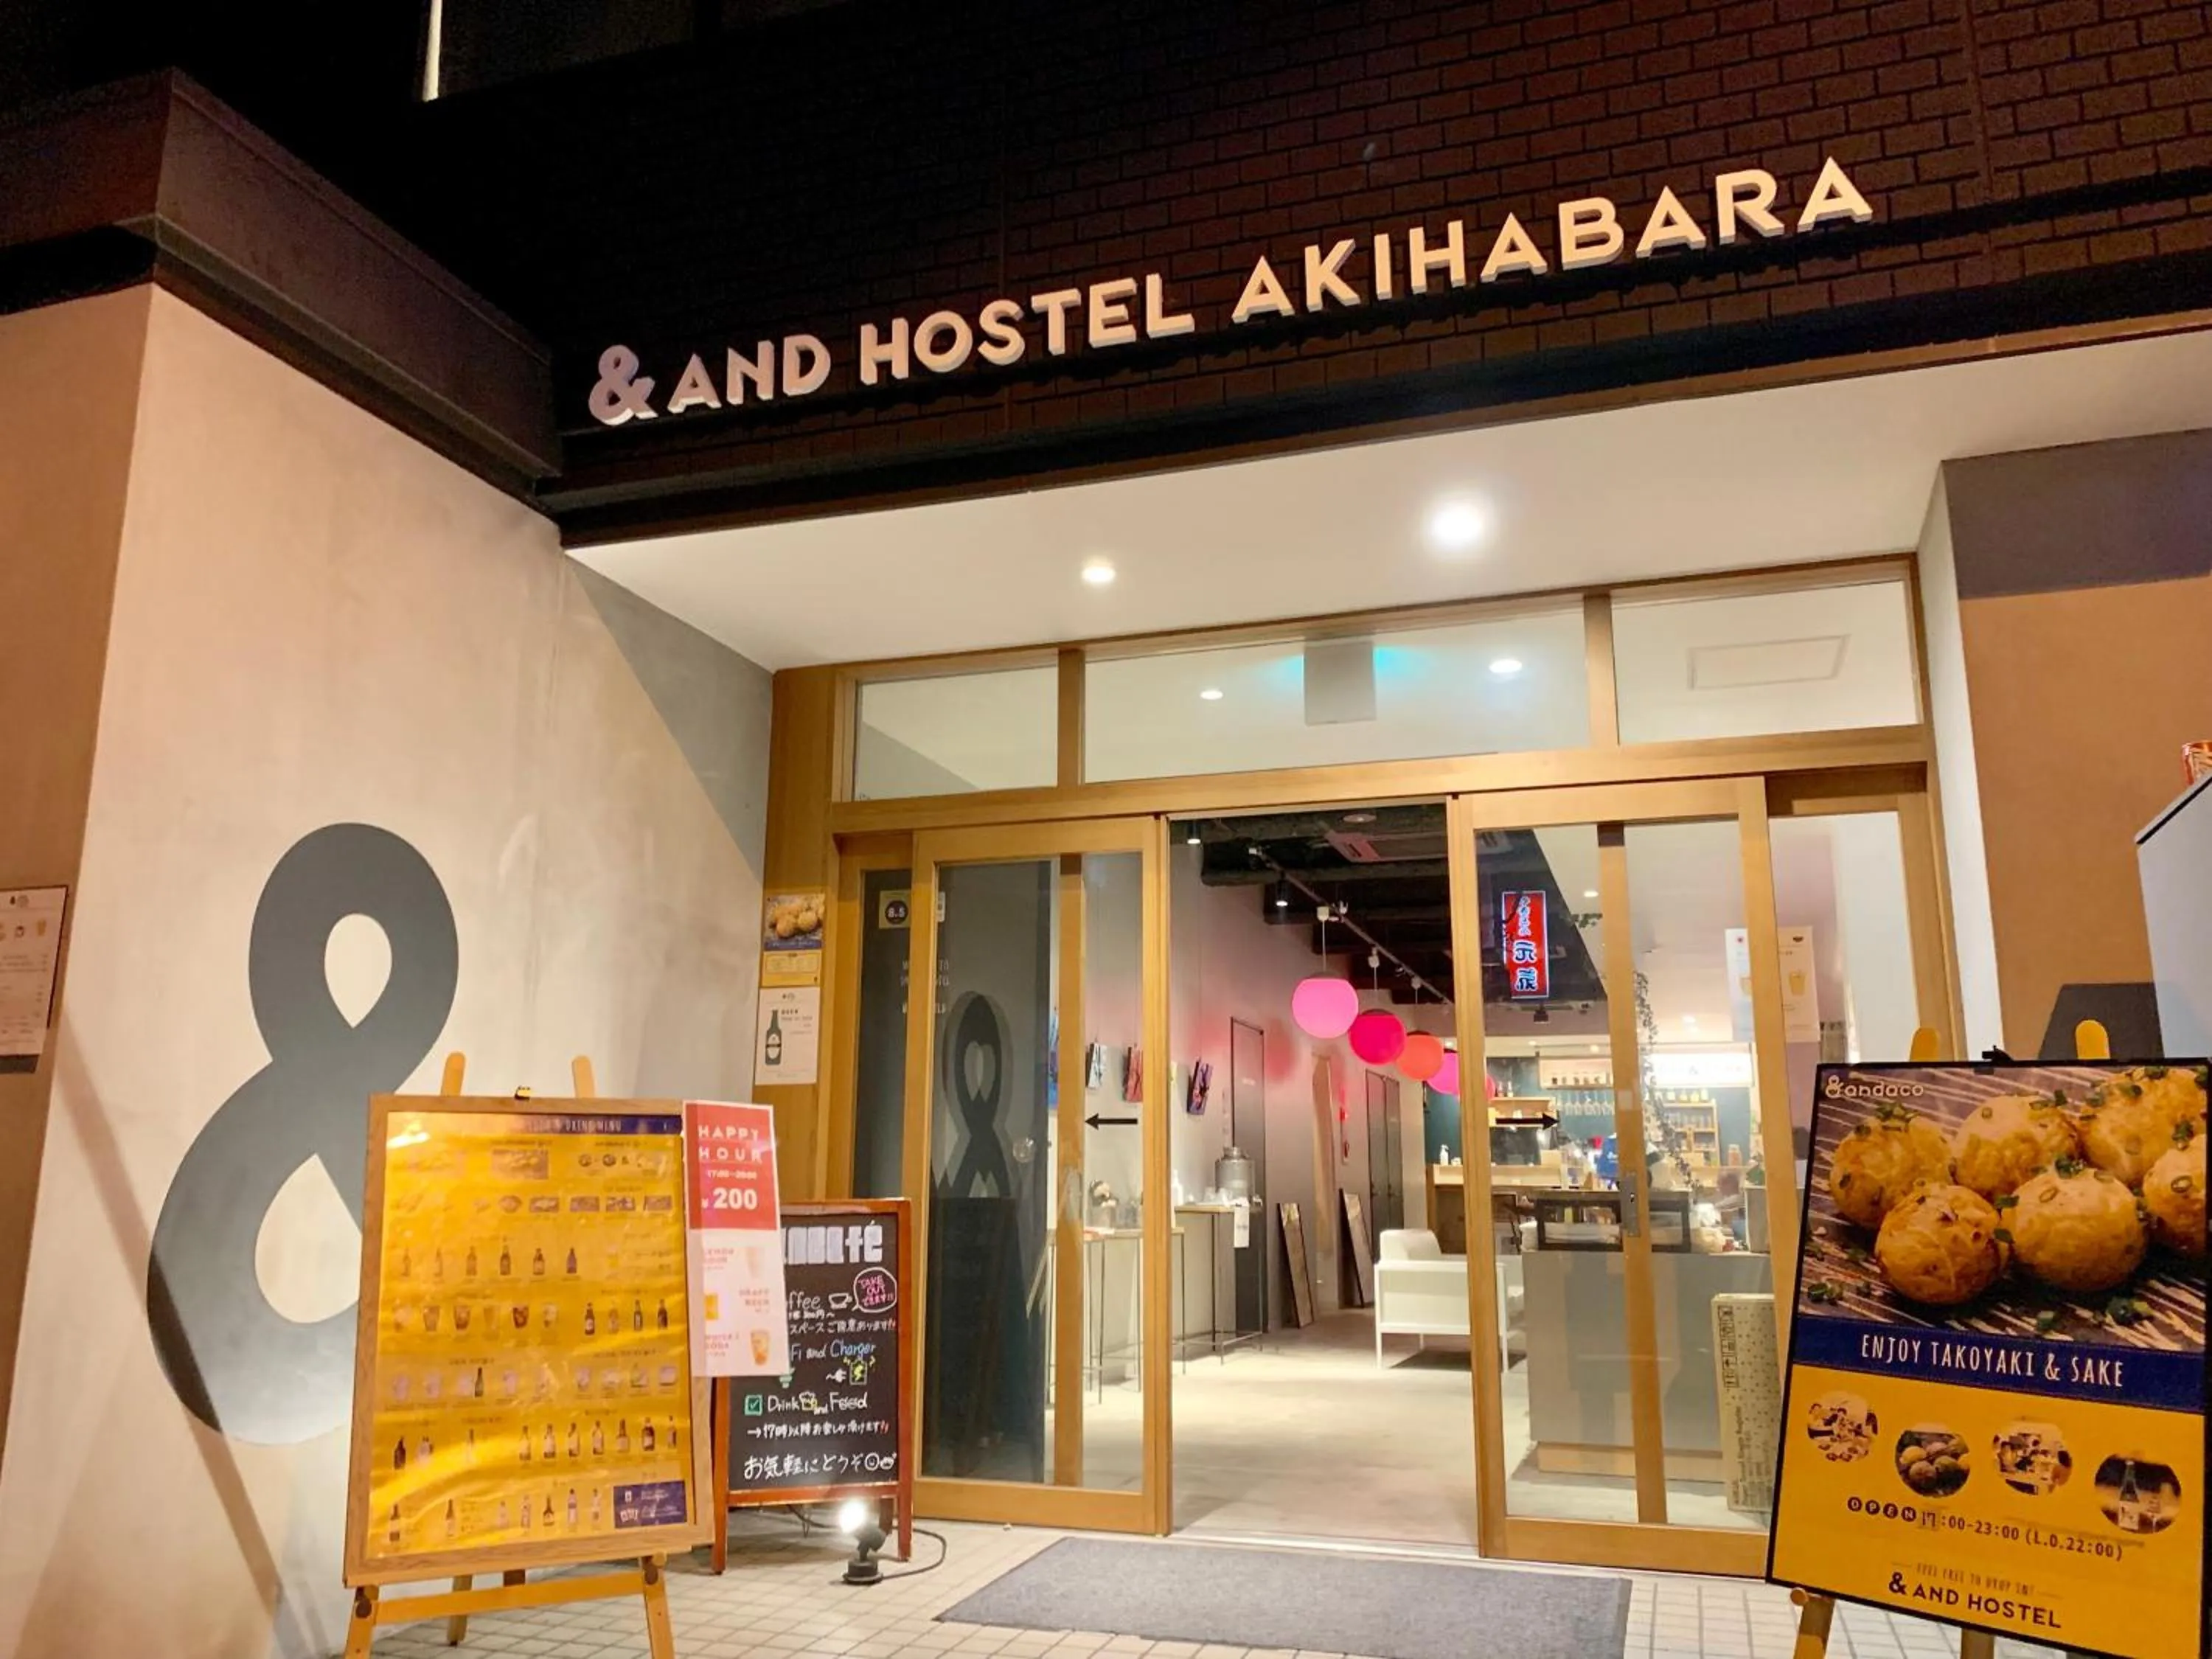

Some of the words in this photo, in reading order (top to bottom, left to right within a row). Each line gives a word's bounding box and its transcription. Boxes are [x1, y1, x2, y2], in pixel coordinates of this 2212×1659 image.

[588, 344, 658, 426] &
[667, 334, 831, 413] AND
[860, 273, 1194, 386] HOSTEL
[1231, 156, 1872, 323] AKIHABARA
[698, 1124, 759, 1141] HAPPY
[699, 1146, 762, 1164] HOUR
[858, 1275, 884, 1288] TAKE
[867, 1285, 885, 1295] OUT
[787, 1291, 821, 1310] ffee
[807, 1342, 828, 1360] and
[830, 1339, 876, 1360] Charger
[1862, 1334, 1921, 1363] ENJOY
[1931, 1341, 2034, 1377] TAKOYAKI
[2045, 1353, 2061, 1381] &
[2071, 1355, 2124, 1387] SAKE
[768, 1395, 799, 1412] Drink
[1848, 1498, 1916, 1520] OPEN
[1888, 1571, 1907, 1596] &
[1913, 1583, 1958, 1605] AND
[1968, 1593, 2062, 1628] HOSTEL
